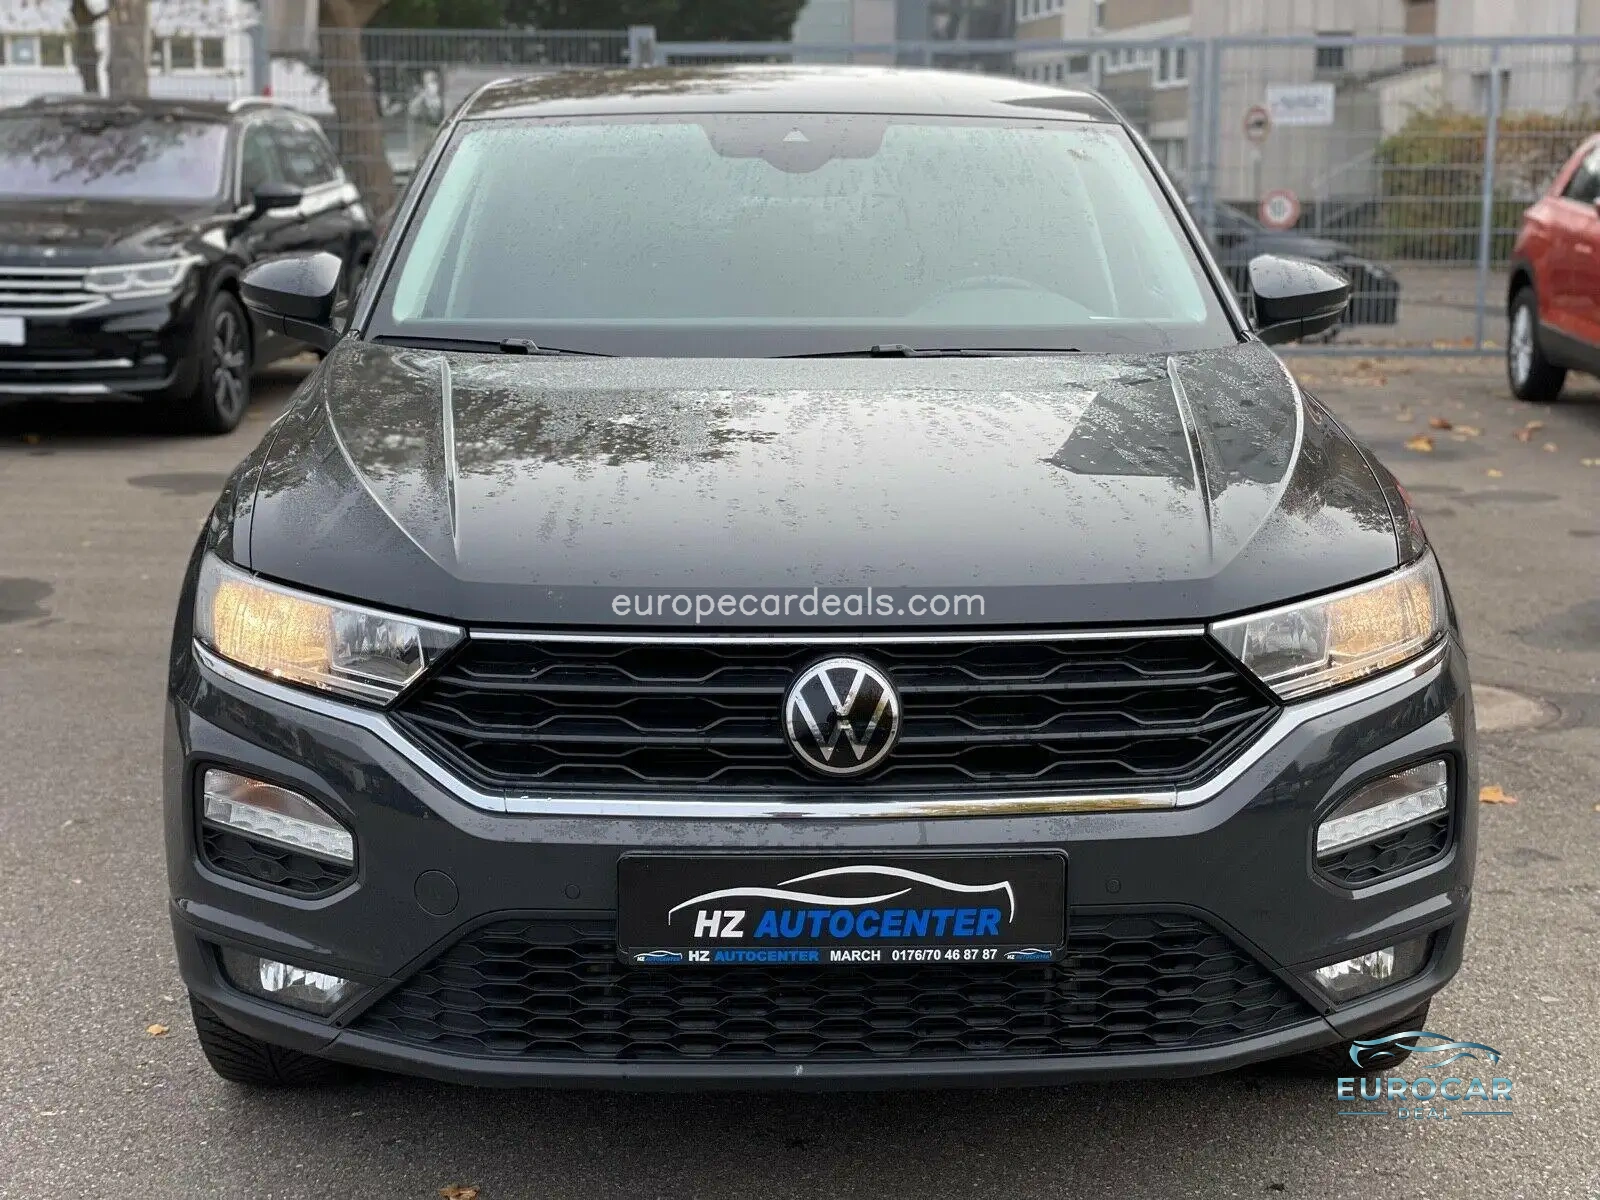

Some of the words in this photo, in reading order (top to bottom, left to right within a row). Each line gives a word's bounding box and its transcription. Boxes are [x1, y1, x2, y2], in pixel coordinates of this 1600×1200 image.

[694, 910, 746, 937] HZ
[754, 907, 1001, 938] AUTOCENTER
[688, 950, 710, 961] HZ
[714, 950, 819, 962] AUTOCENTER
[830, 950, 881, 962] MARCH
[891, 949, 941, 961] 0176/70
[944, 949, 960, 961] 46
[963, 949, 979, 960] 87
[982, 949, 998, 960] 87
